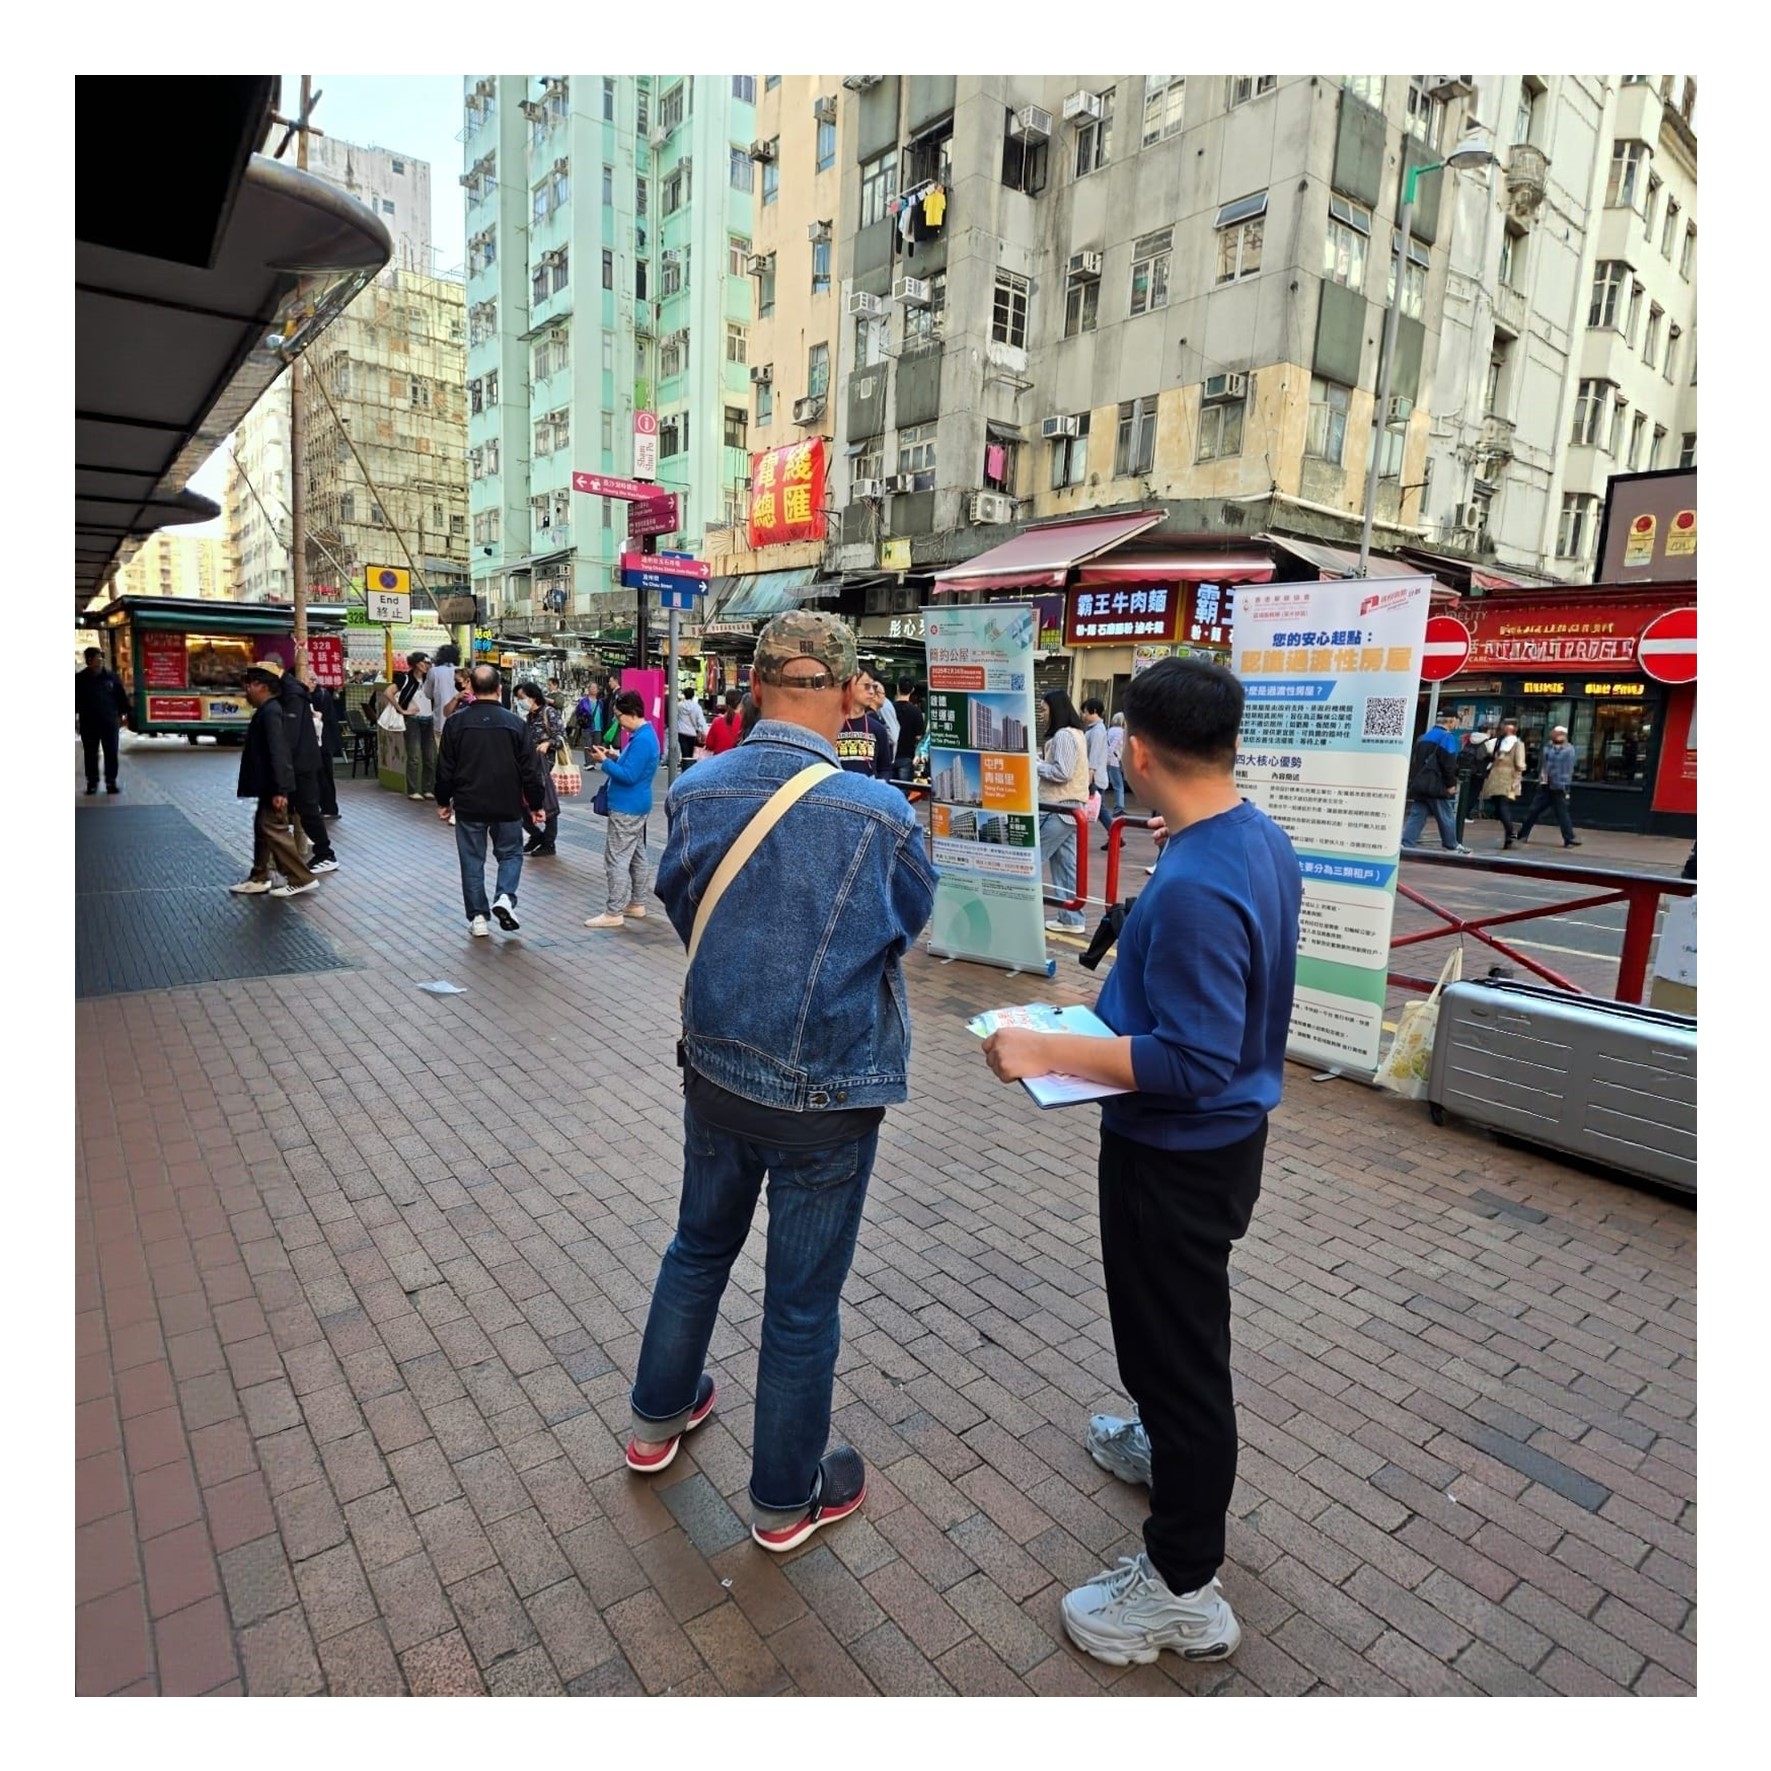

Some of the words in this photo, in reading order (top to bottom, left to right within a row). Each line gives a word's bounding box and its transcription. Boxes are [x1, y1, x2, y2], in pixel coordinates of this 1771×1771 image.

[646, 442, 654, 452] Po
[637, 445, 645, 468] Sham
[645, 455, 654, 472] Shui
[380, 595, 399, 605] End
[1077, 588, 1168, 616] 霸王牛肉麵
[376, 607, 403, 619] 終止
[312, 641, 331, 650] 328
[1240, 647, 1412, 673] 認識過渡性房屋
[984, 758, 1004, 771] 屯門
[1235, 754, 1302, 769] 四大核心優勢
[984, 772, 1014, 786] 青福里
